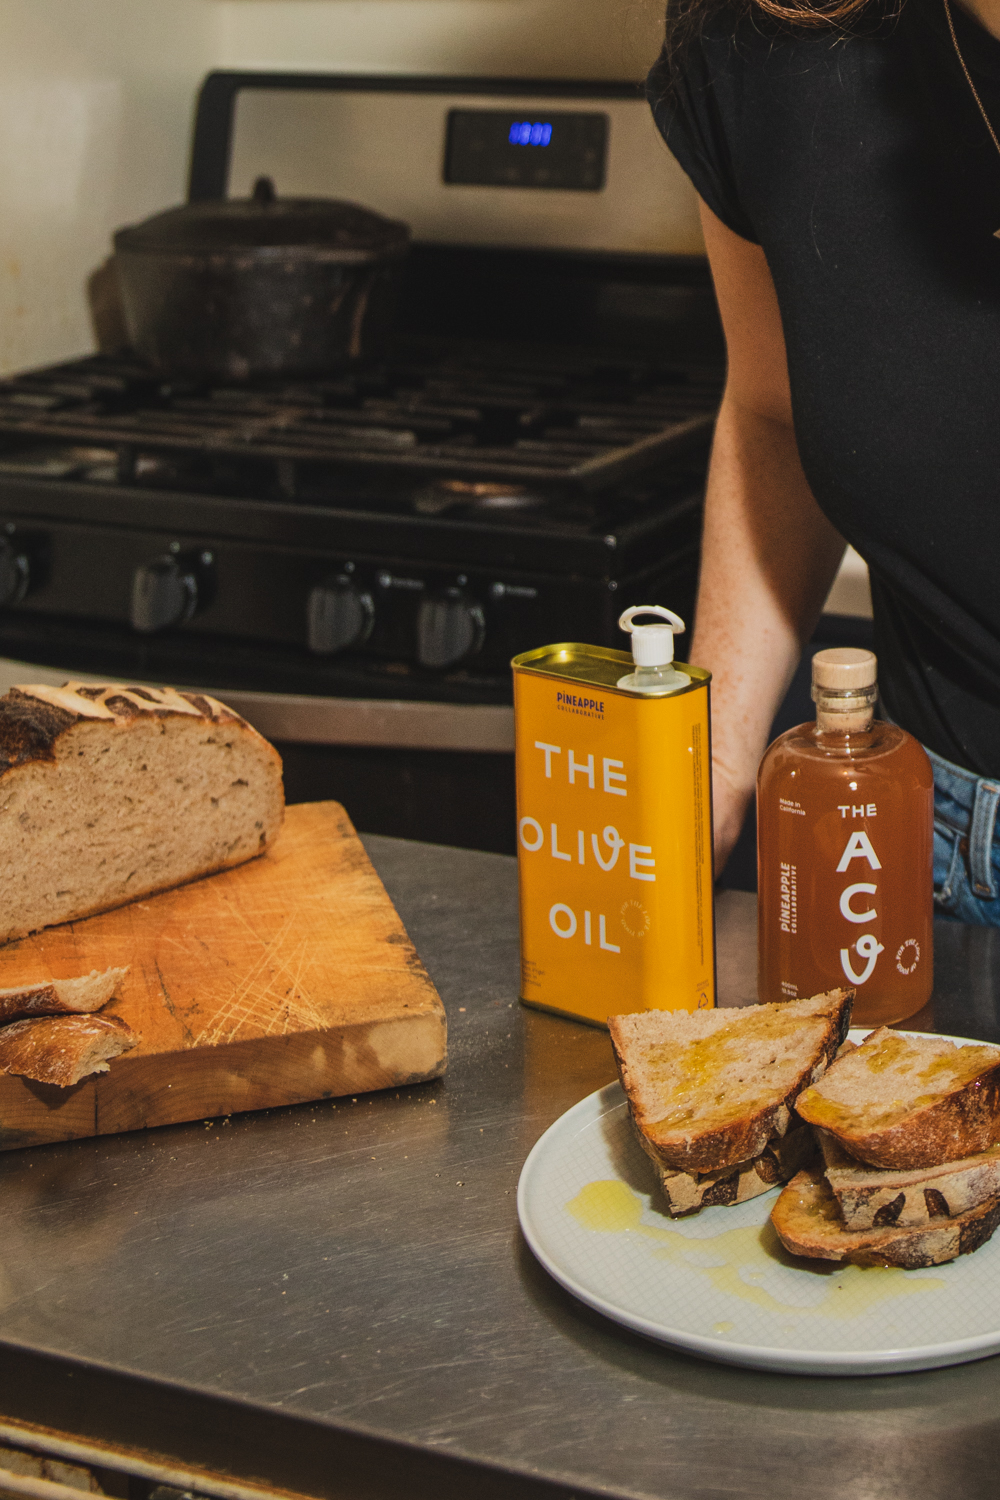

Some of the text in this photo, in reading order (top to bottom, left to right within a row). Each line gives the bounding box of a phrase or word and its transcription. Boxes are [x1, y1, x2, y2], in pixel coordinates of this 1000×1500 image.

[556, 690, 605, 713] PINEAPPLE
[556, 704, 605, 720] COLLABORATIVE
[534, 740, 628, 797] THE
[779, 797, 794, 807] Made
[779, 804, 806, 816] California
[837, 803, 877, 819] THE
[519, 815, 656, 882] OLIVE
[779, 861, 791, 933] PINEAPPLE
[790, 864, 798, 934] COLLABORATIVE
[549, 902, 621, 954] OIL
